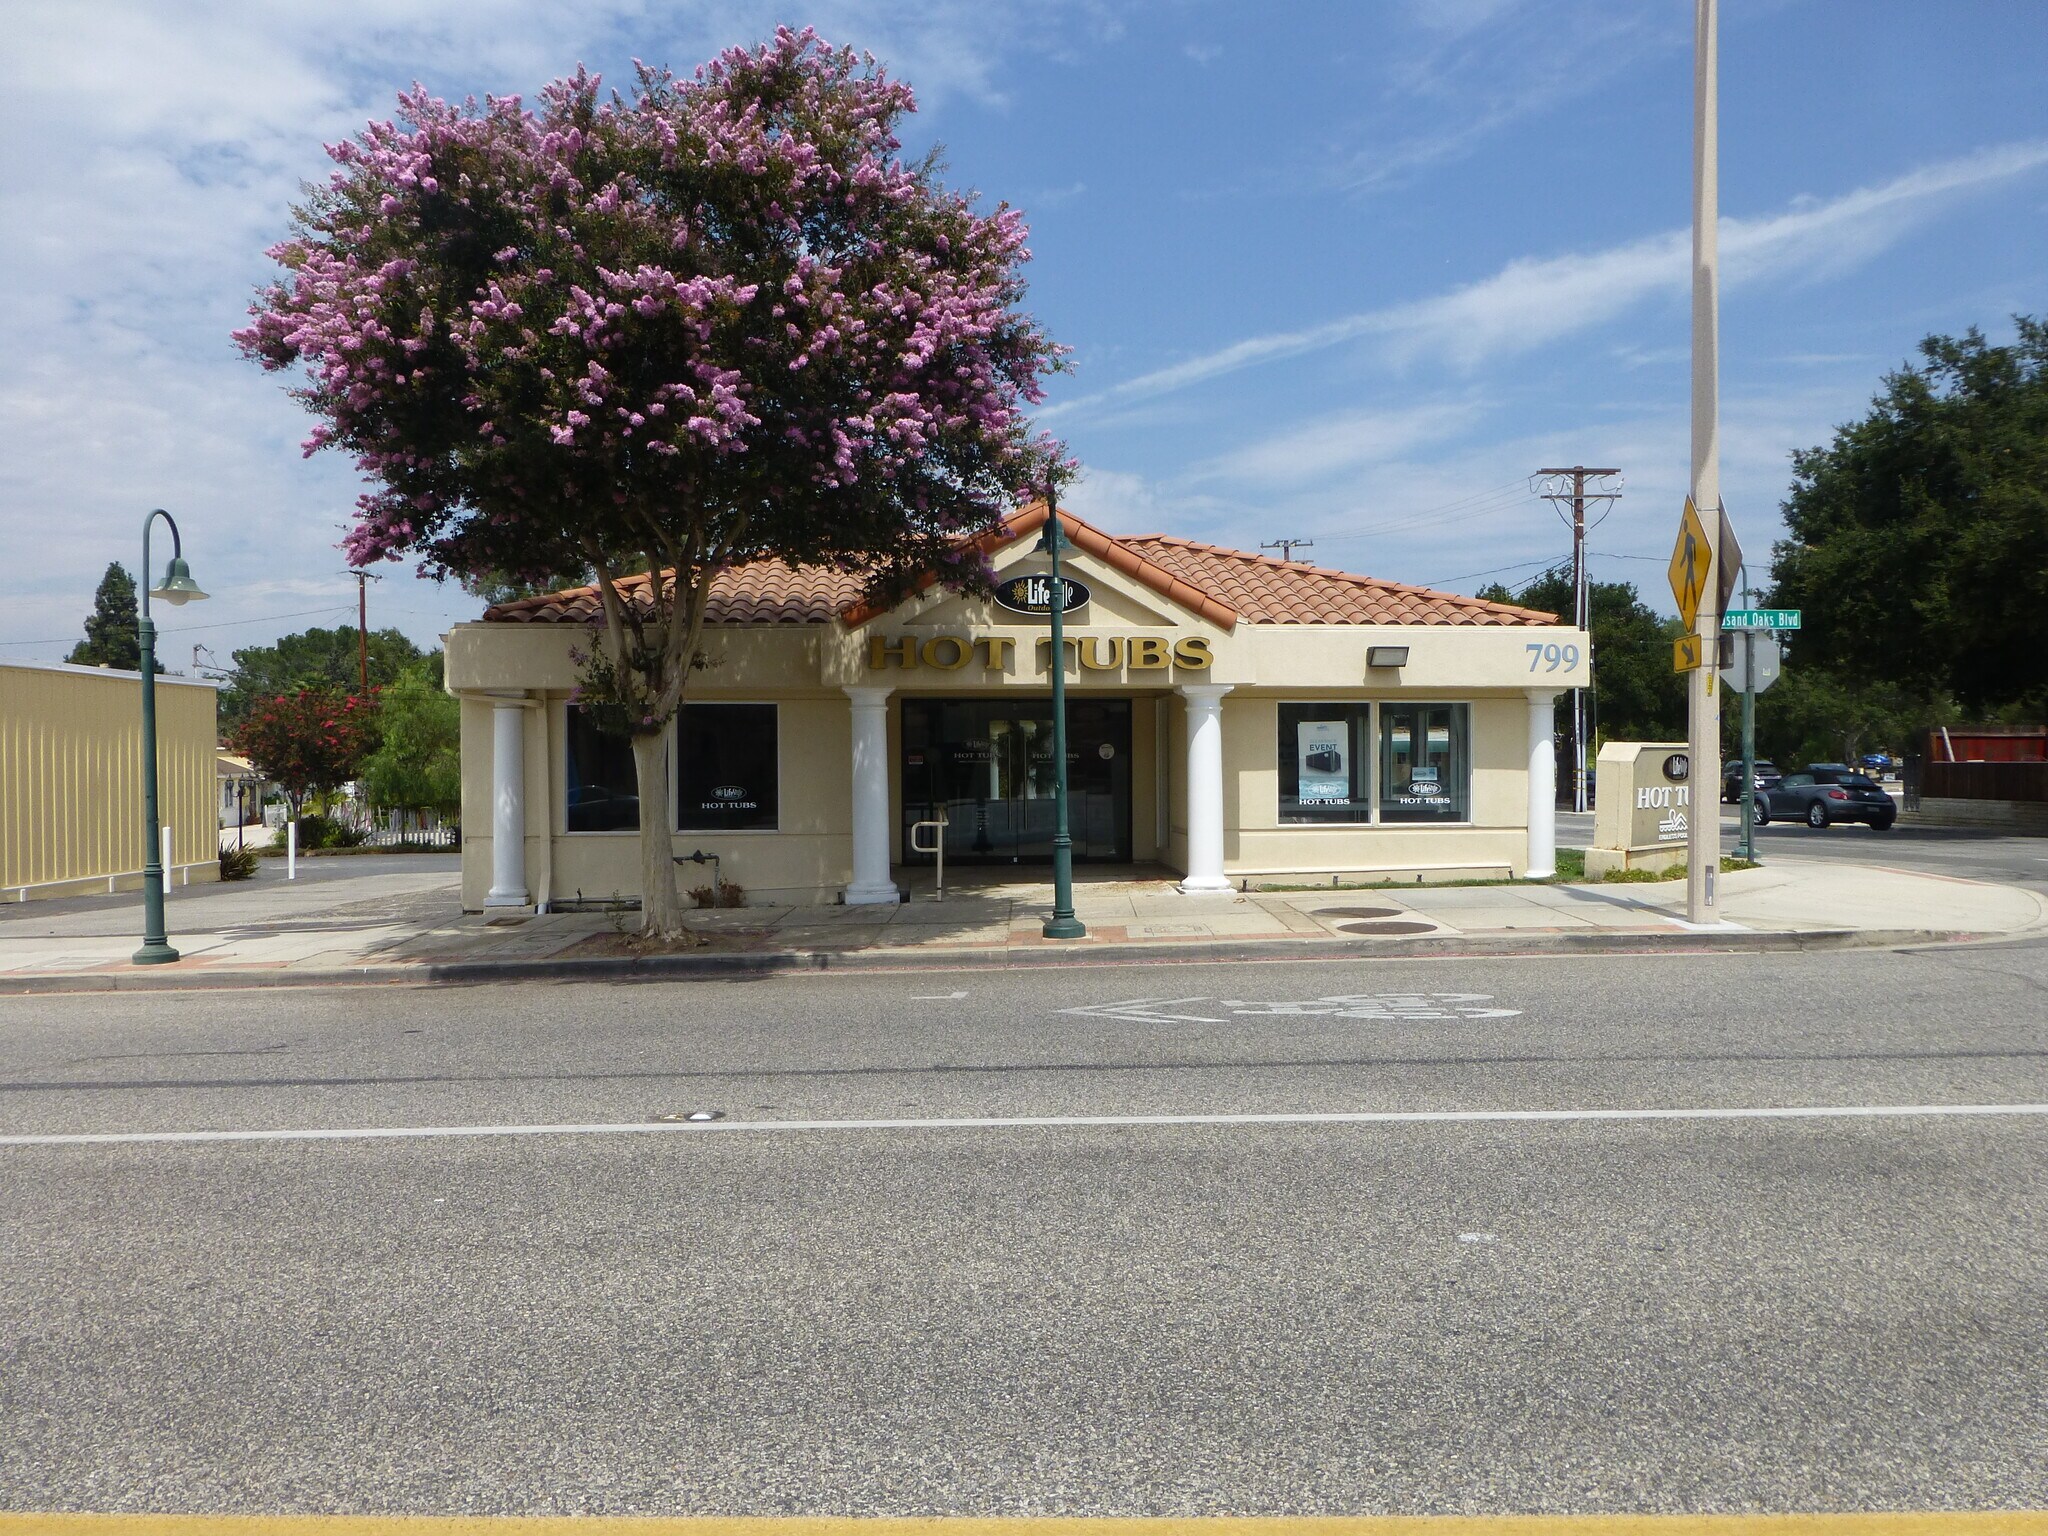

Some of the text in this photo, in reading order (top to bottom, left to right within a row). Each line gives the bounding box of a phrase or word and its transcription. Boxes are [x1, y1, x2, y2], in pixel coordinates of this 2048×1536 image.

[1722, 612, 1798, 626] sand Oaks Blvd
[868, 635, 1017, 670] HOT
[1526, 643, 1579, 673] 799
[1309, 743, 1338, 751] EVENT
[1637, 785, 1672, 809] HOT
